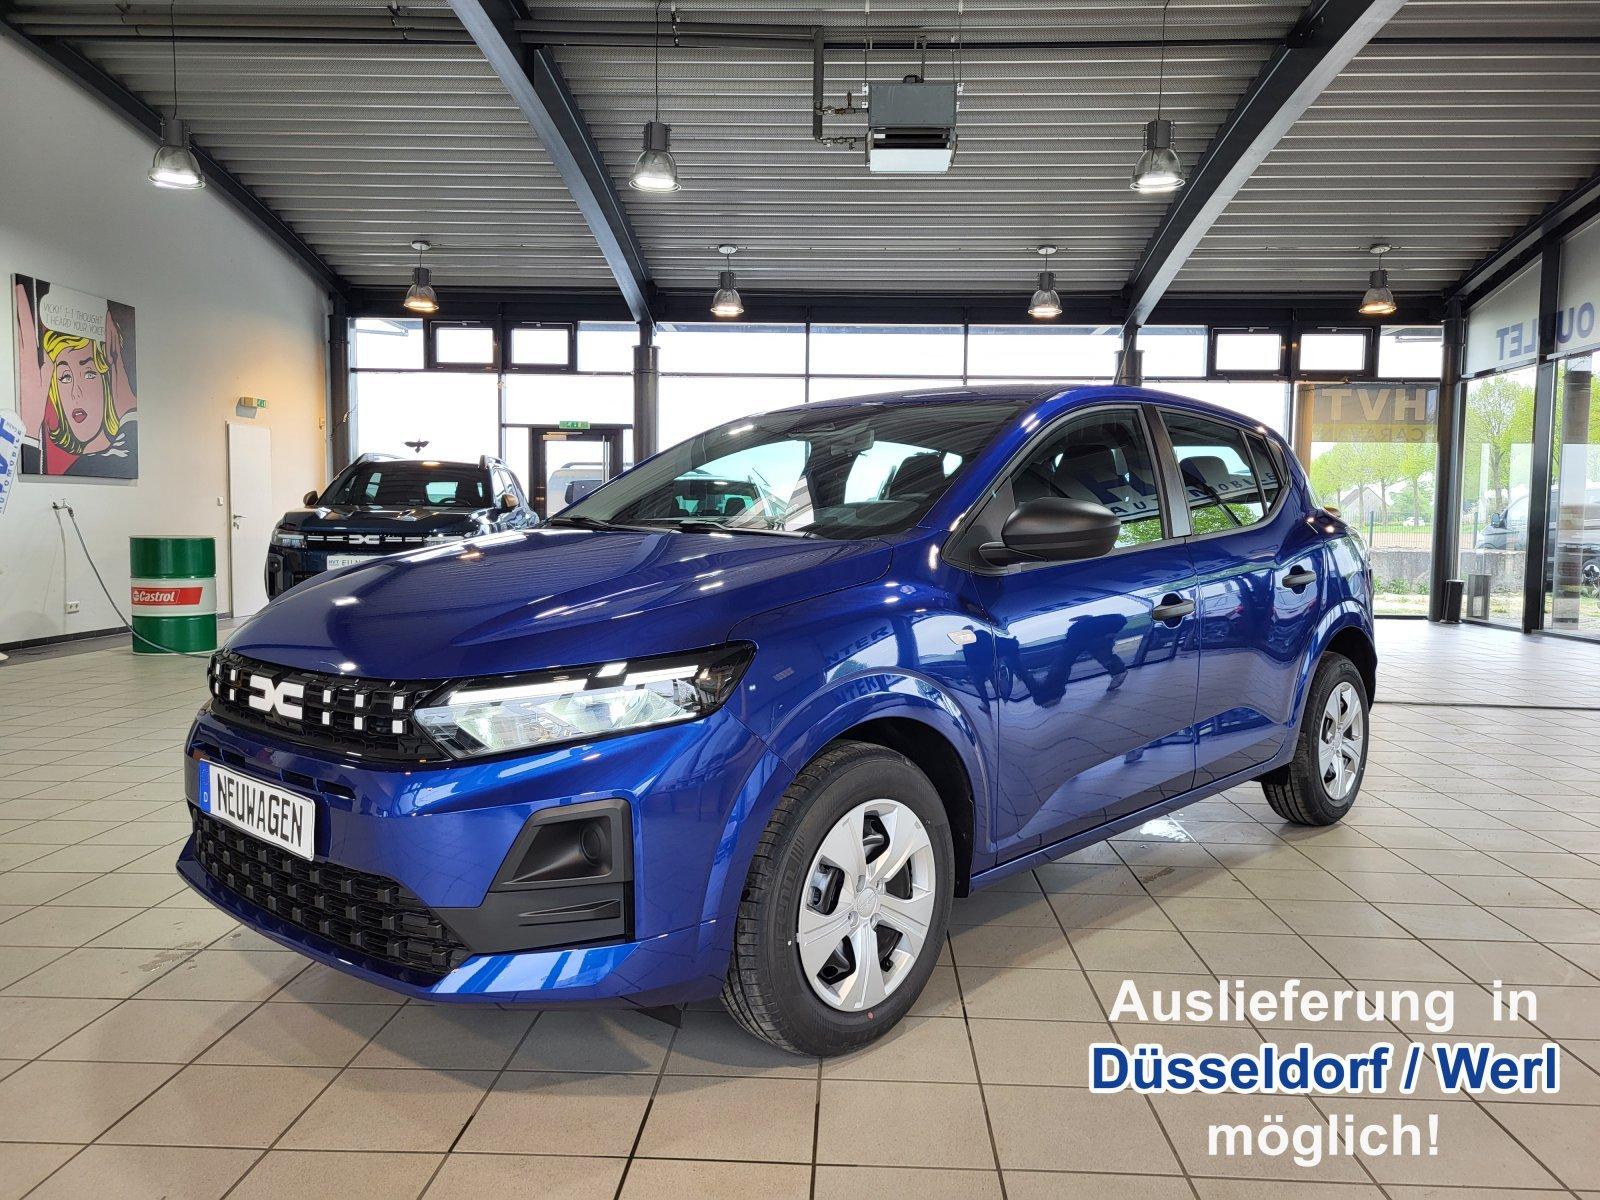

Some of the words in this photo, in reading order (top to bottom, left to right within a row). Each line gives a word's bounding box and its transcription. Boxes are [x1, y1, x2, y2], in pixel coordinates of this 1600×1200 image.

[50, 314, 72, 328] HEARD
[73, 321, 88, 332] YOUR
[76, 310, 103, 325] THOUGHT
[139, 590, 176, 603] Castrol
[203, 791, 208, 802] D
[217, 773, 303, 847] NEUWAGEN
